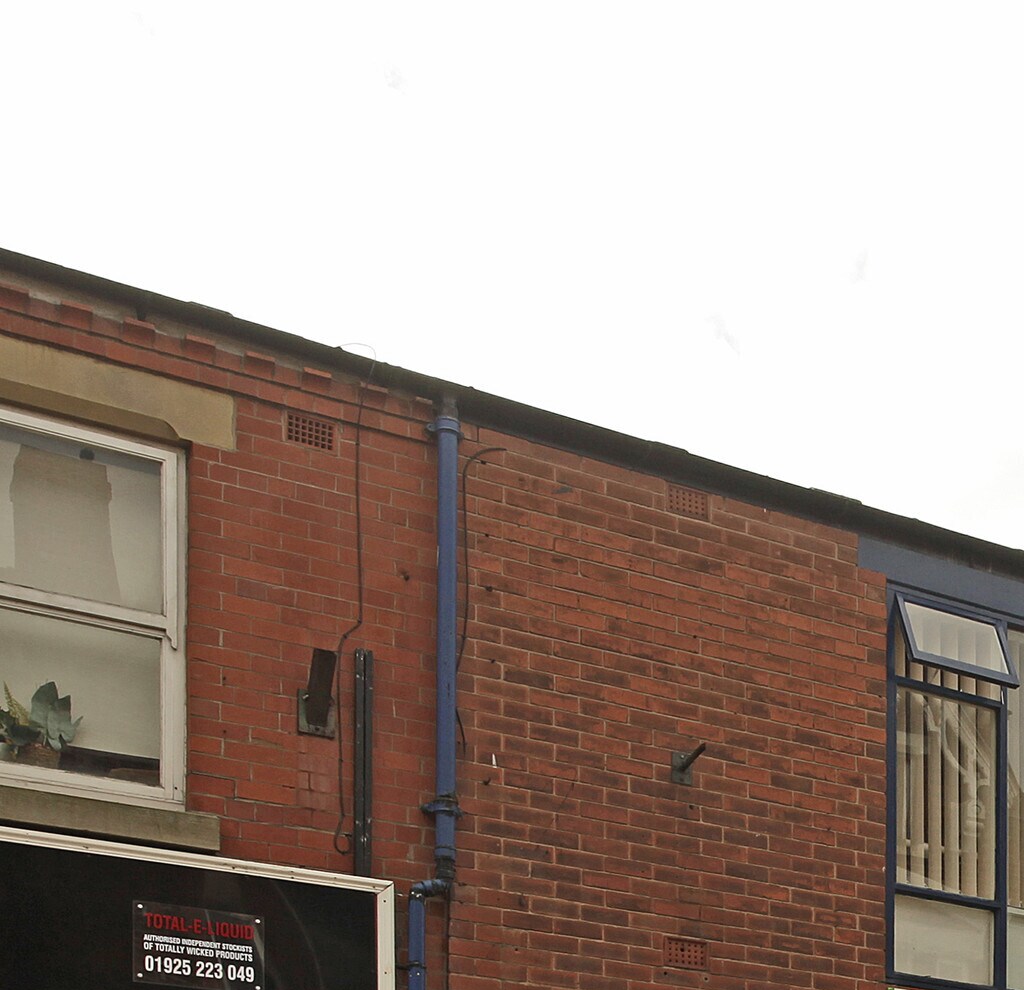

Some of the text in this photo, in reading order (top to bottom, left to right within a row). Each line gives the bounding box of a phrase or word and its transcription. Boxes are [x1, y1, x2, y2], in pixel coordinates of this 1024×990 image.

[143, 934, 253, 953] AUTHORISED INDEPENDENT STOCKISTS
[143, 941, 253, 962] OF TOTALLY WICKED PRODUCTS
[144, 955, 255, 983] 01925 223 049
